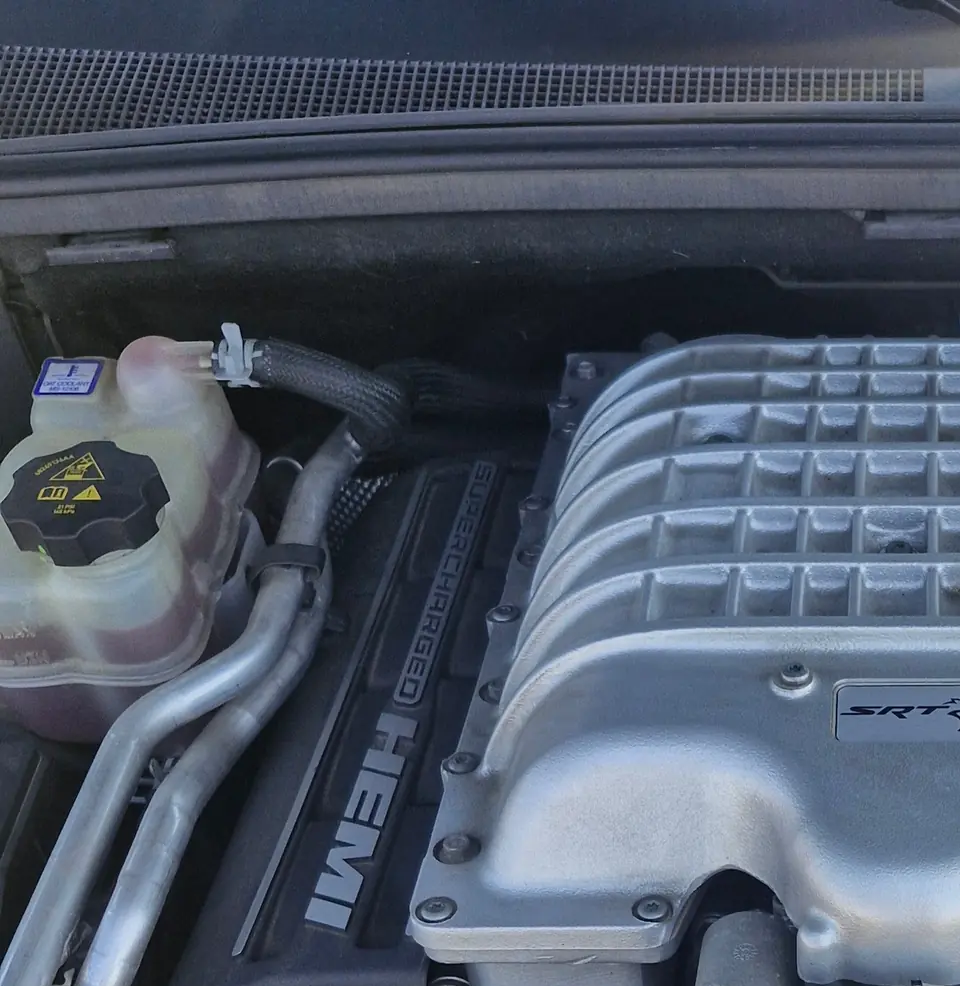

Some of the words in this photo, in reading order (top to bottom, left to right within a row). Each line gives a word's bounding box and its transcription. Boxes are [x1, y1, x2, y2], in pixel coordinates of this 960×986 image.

[398, 462, 493, 701] SUPERCHARGED
[304, 712, 419, 930] HEMI
[839, 705, 951, 719] SRT
